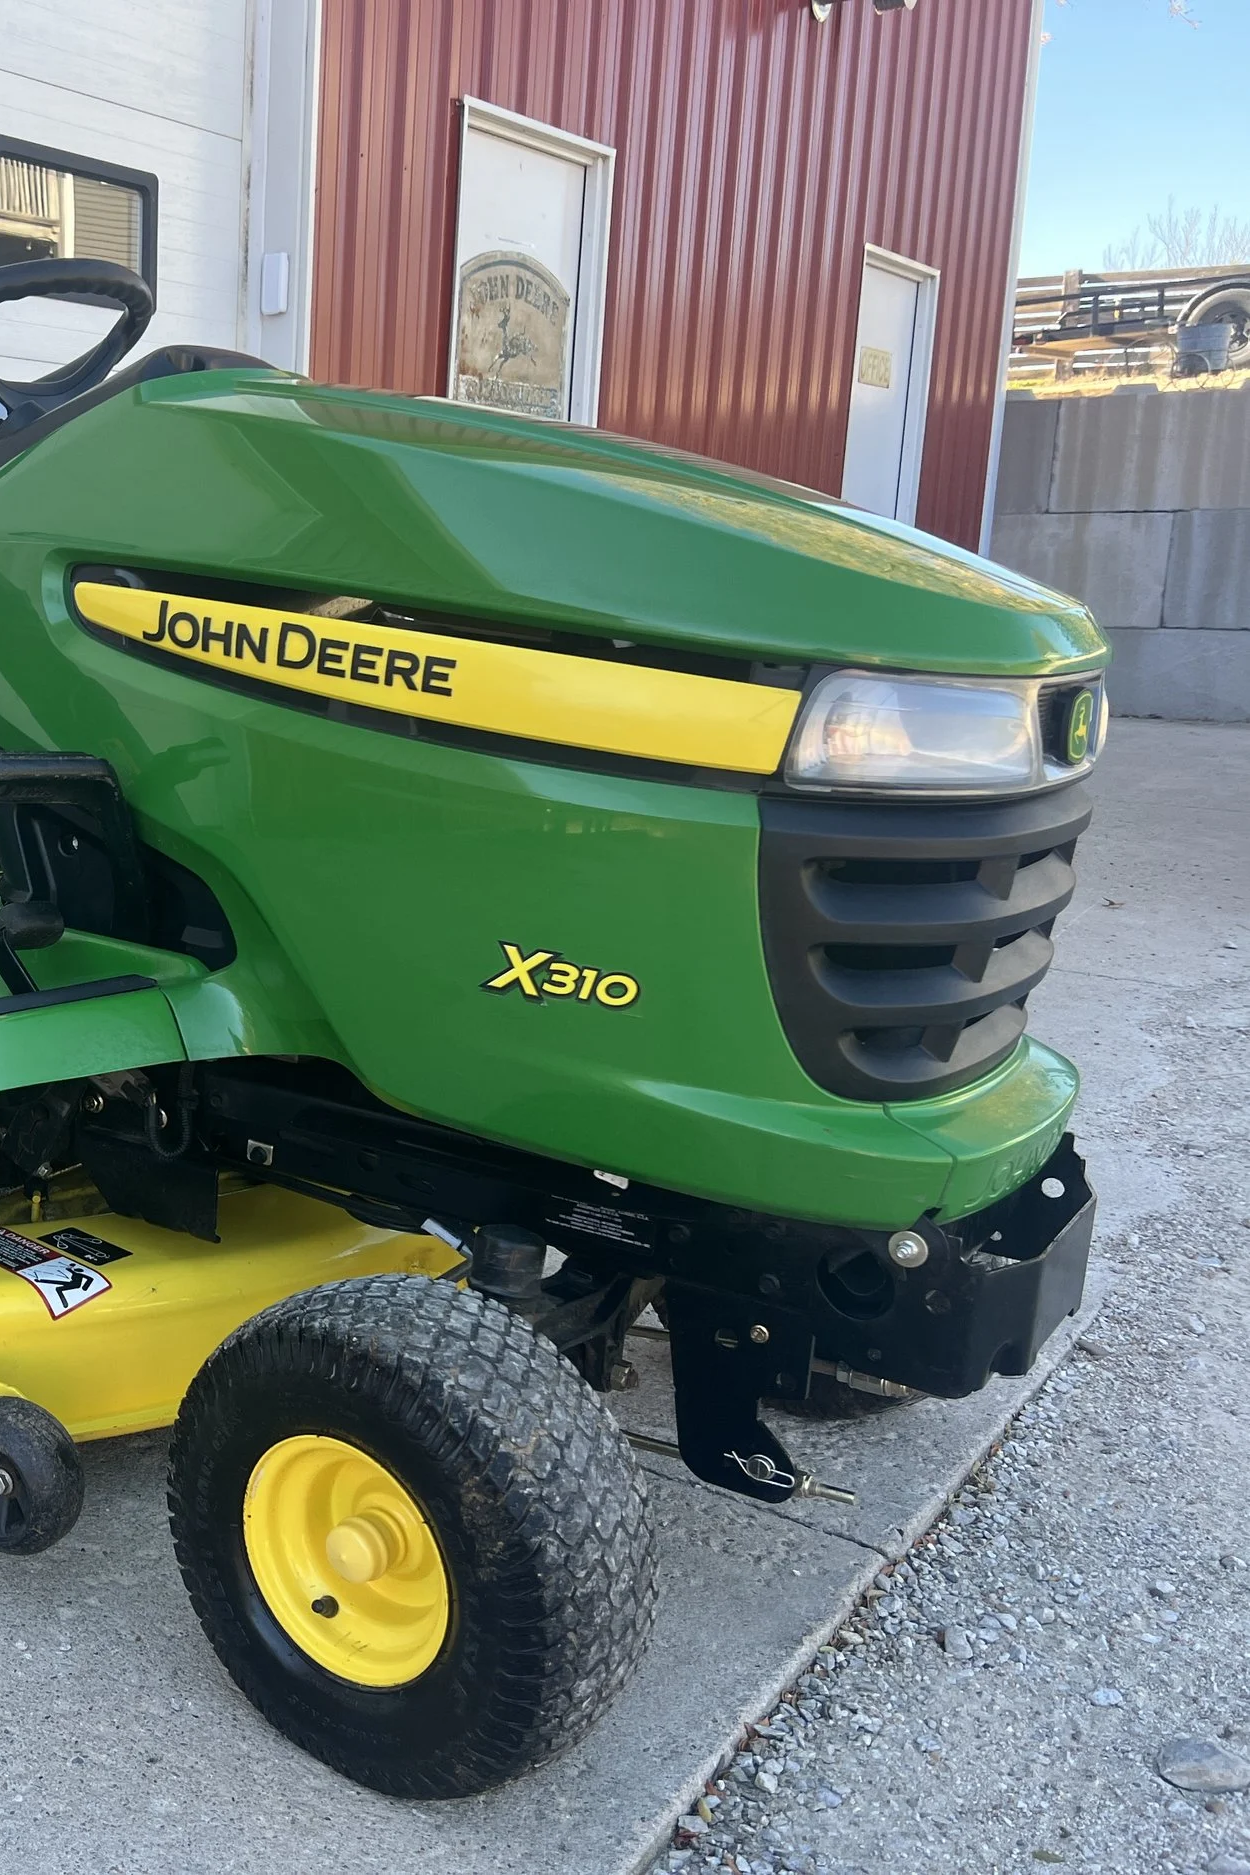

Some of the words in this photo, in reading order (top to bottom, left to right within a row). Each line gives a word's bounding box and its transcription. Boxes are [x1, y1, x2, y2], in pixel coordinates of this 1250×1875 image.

[469, 274, 510, 304] JOHN
[514, 274, 559, 326] DEERE
[142, 599, 270, 664] JOHN
[276, 621, 457, 697] DEERE
[480, 941, 640, 1007] X310
[5, 1231, 51, 1255] DANGER
